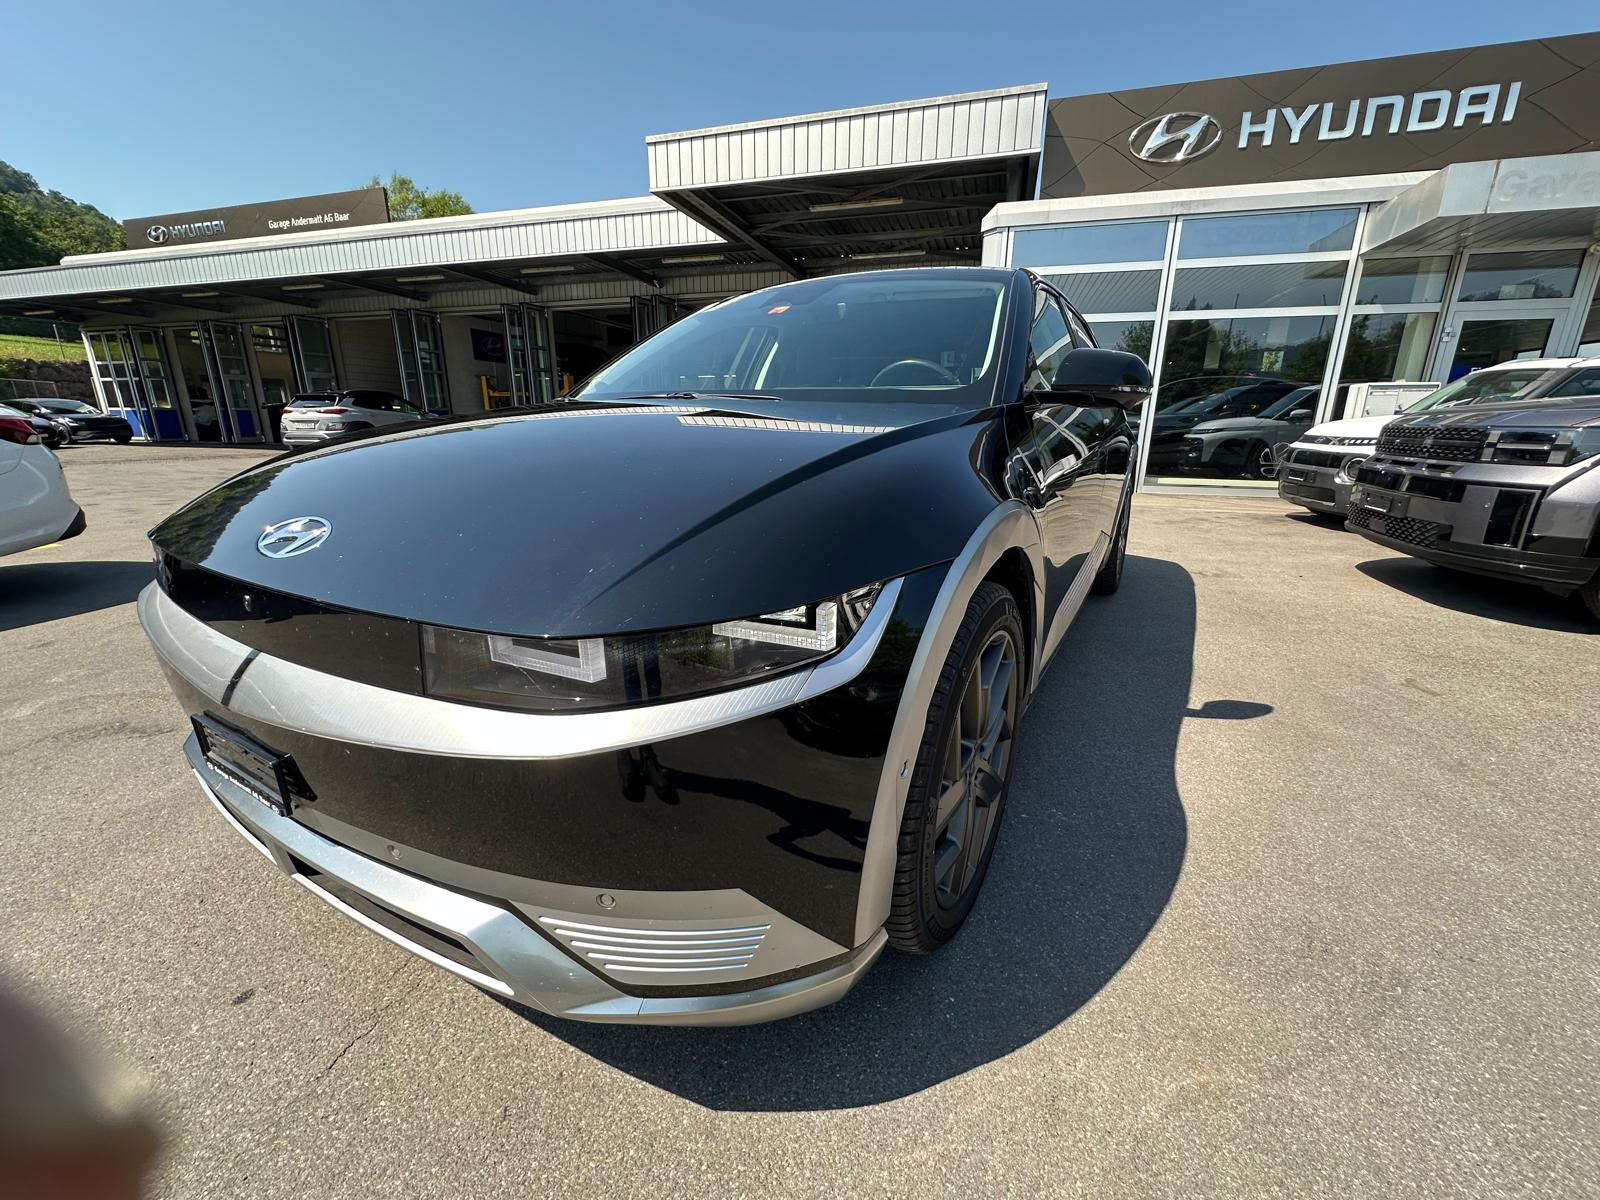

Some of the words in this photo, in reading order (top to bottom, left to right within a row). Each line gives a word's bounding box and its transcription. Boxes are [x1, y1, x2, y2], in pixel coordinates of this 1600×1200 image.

[1237, 80, 1522, 150] HYUNDAI
[170, 220, 226, 239] HYUNDAI
[268, 219, 290, 230] Garage
[291, 214, 323, 227] Andermatt
[324, 213, 334, 223] AG
[334, 212, 350, 222] Baar
